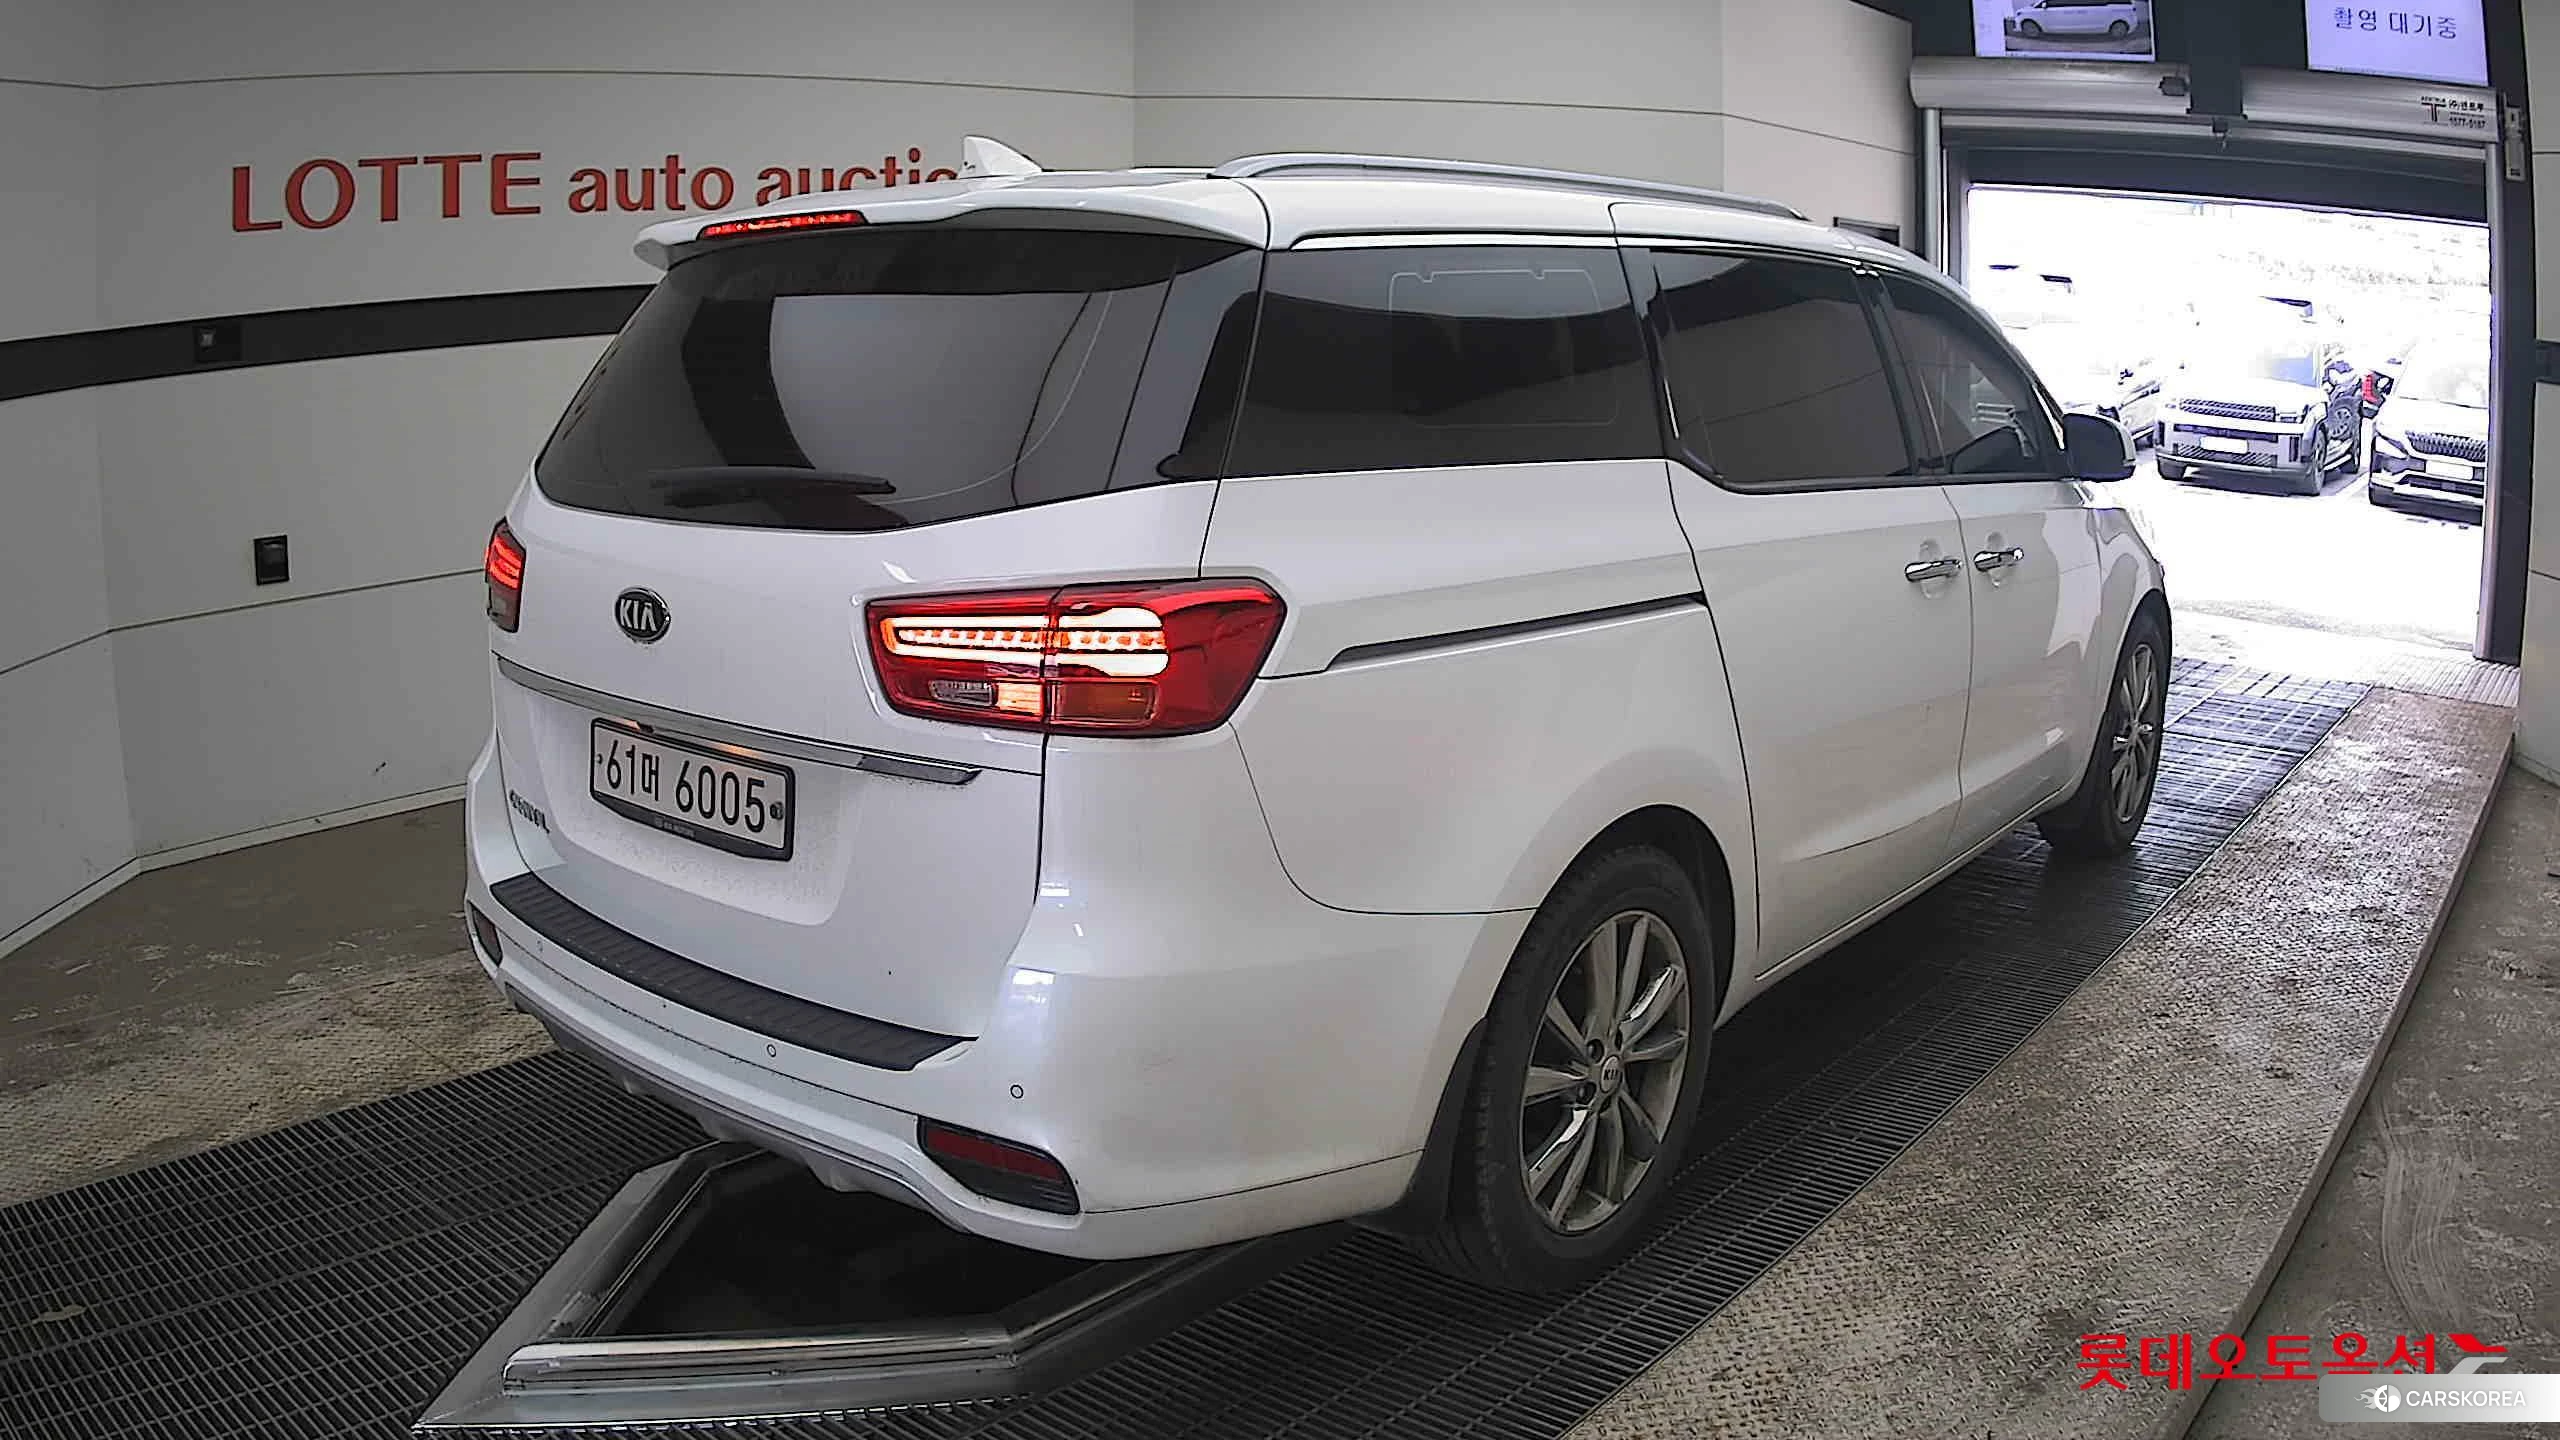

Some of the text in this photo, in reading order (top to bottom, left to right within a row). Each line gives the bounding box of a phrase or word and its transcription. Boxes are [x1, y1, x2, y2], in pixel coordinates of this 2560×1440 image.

[2388, 11, 2457, 40] 대기중
[231, 151, 542, 233] LOTTE
[567, 154, 735, 213] auto
[619, 598, 658, 632] KIA
[606, 739, 766, 833] 61머 6005
